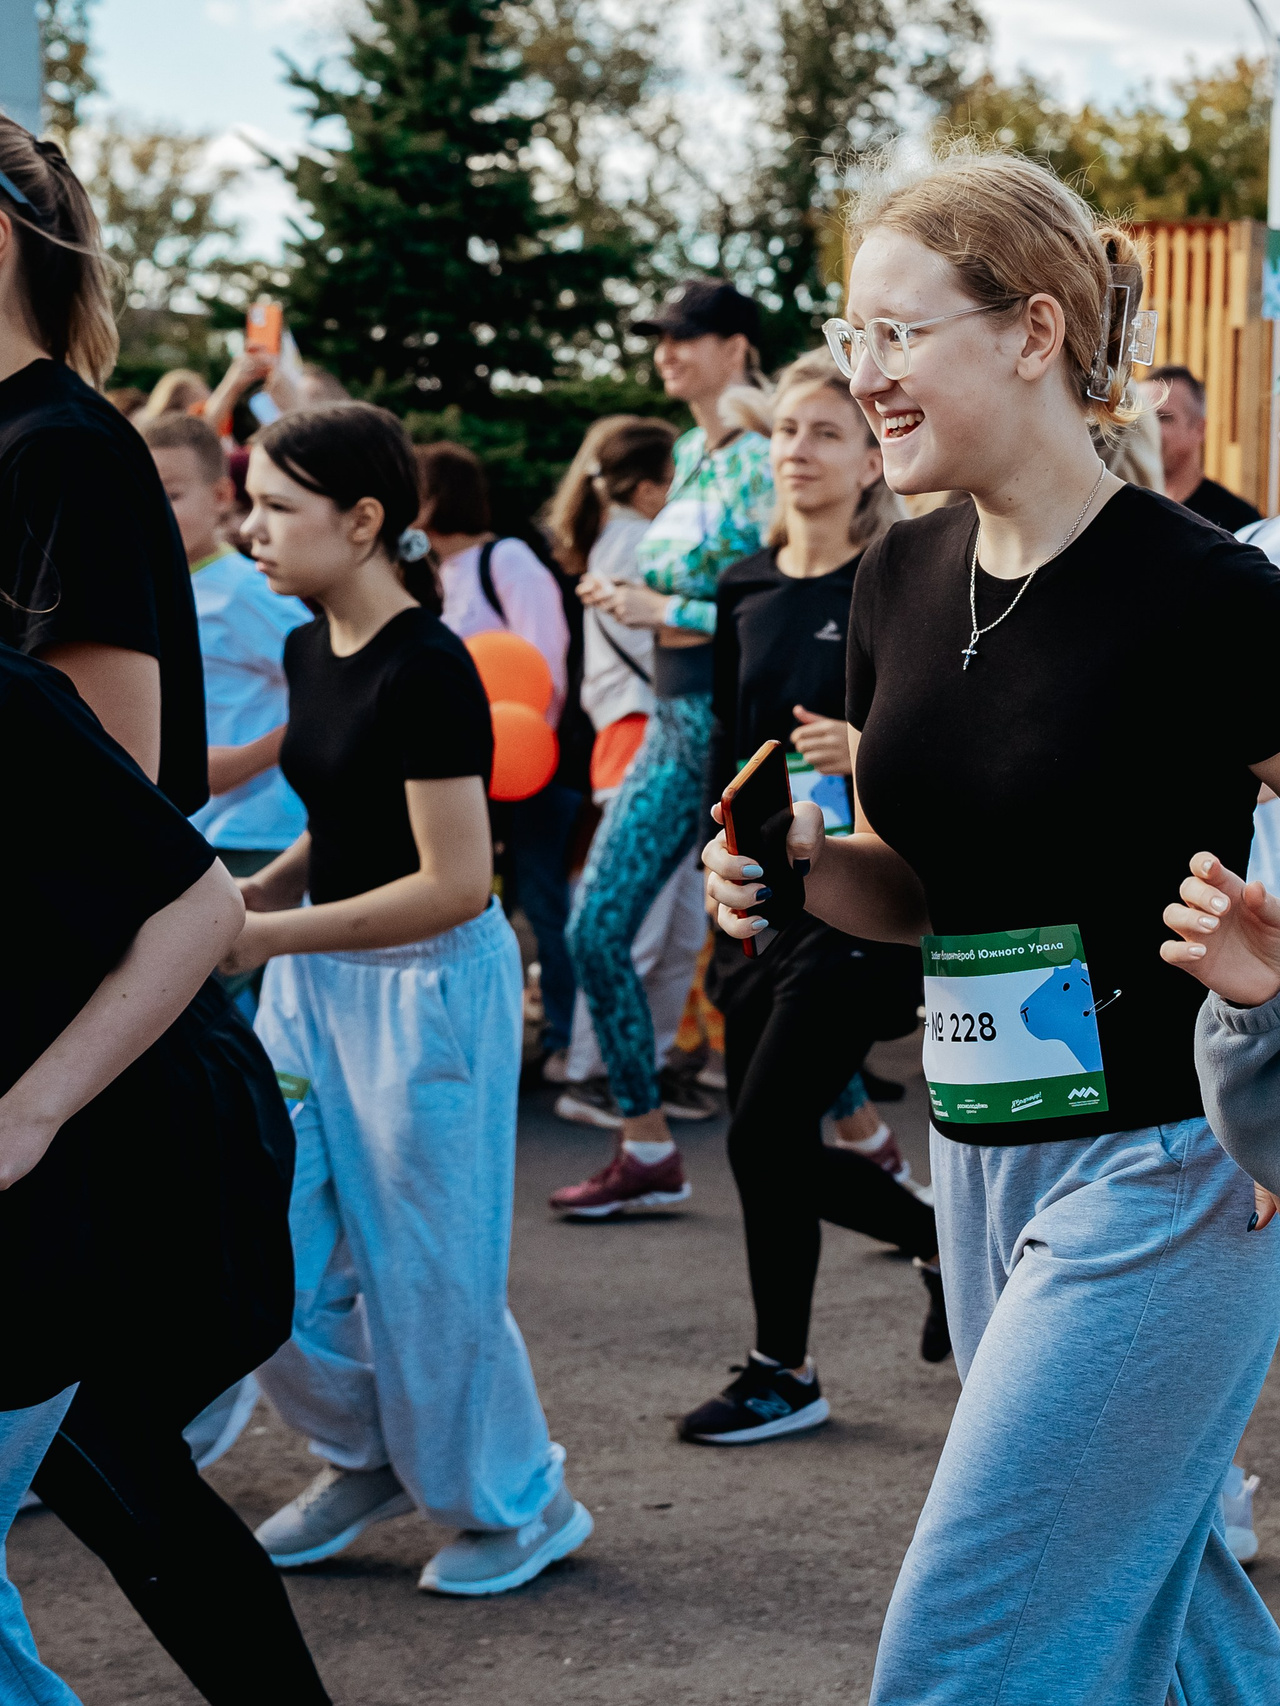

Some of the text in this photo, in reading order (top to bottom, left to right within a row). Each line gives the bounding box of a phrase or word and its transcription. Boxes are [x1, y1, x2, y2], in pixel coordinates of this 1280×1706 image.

[977, 947, 1025, 960] Южного
[1027, 942, 1064, 954] Урала
[950, 1012, 997, 1043] 228
